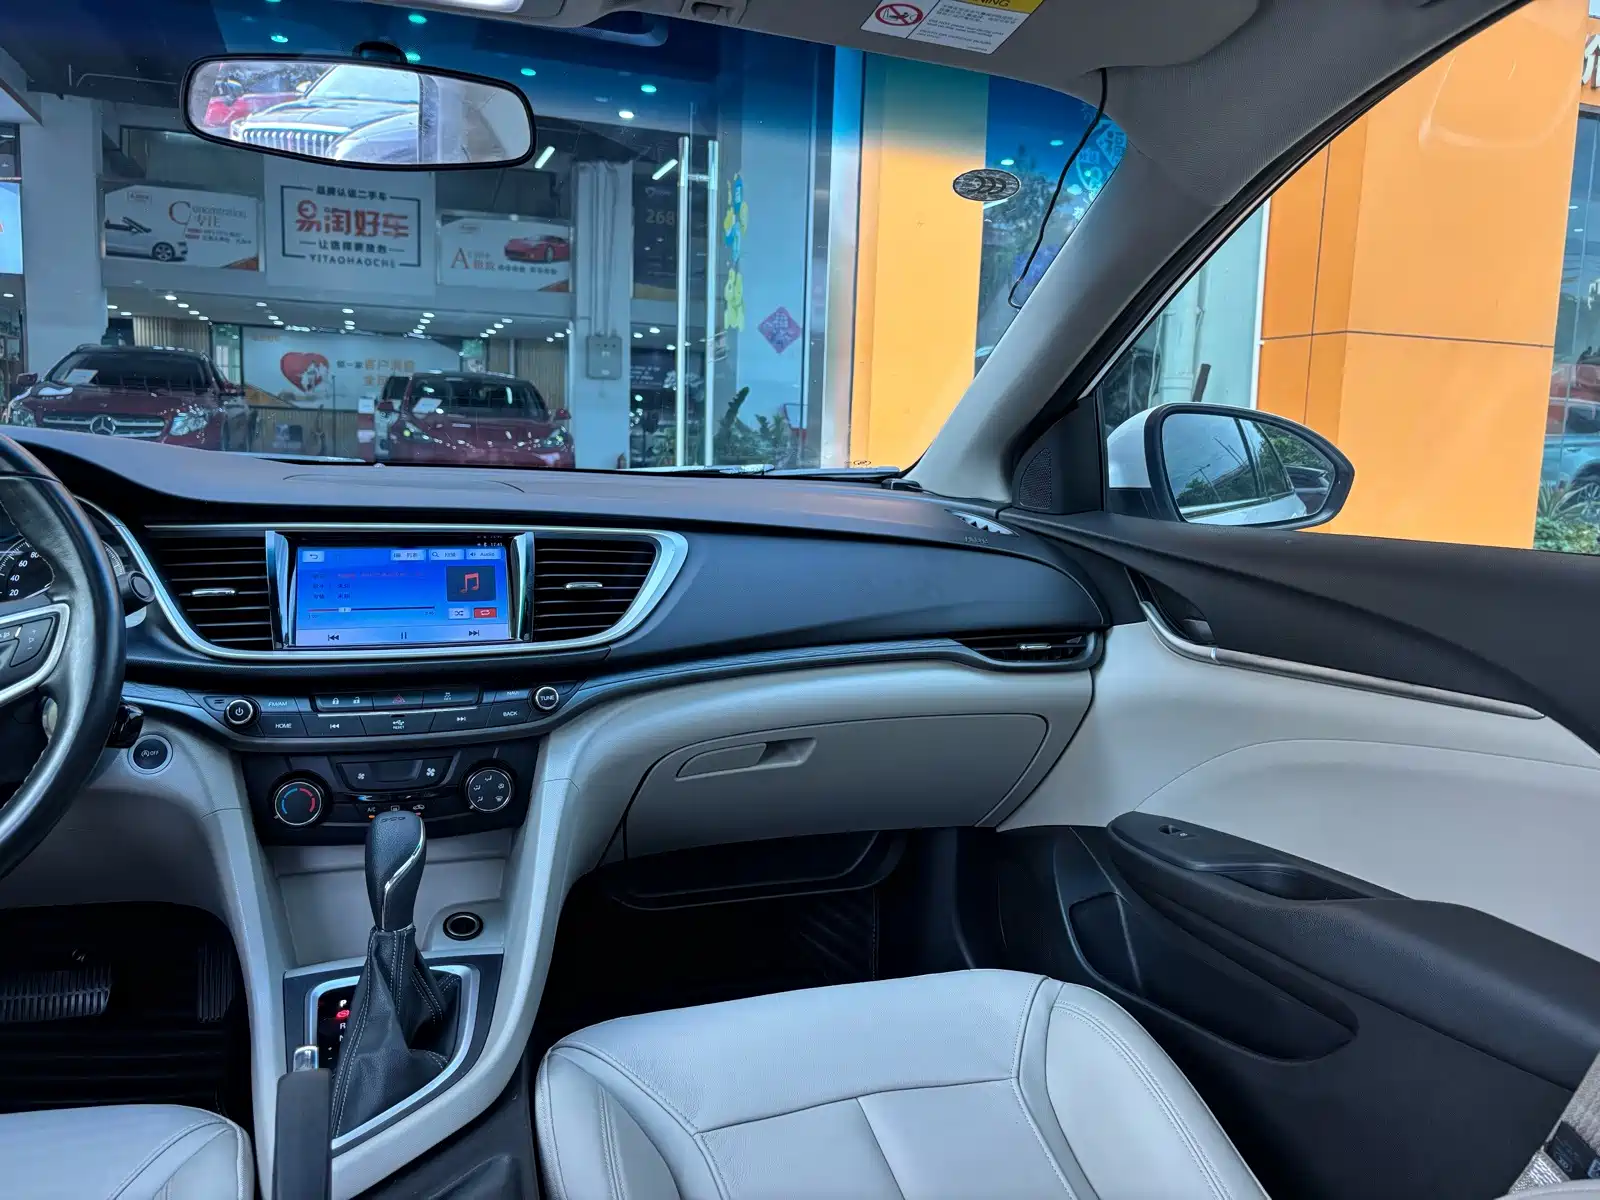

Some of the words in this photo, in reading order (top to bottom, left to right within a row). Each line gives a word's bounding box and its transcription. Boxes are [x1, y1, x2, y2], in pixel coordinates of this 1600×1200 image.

[295, 200, 409, 239] 易淘好车
[310, 253, 396, 269] YITAOHAOCHE
[10, 574, 20, 582] 40
[9, 588, 19, 596] 20
[339, 999, 347, 1008] P
[339, 1022, 346, 1030] R
